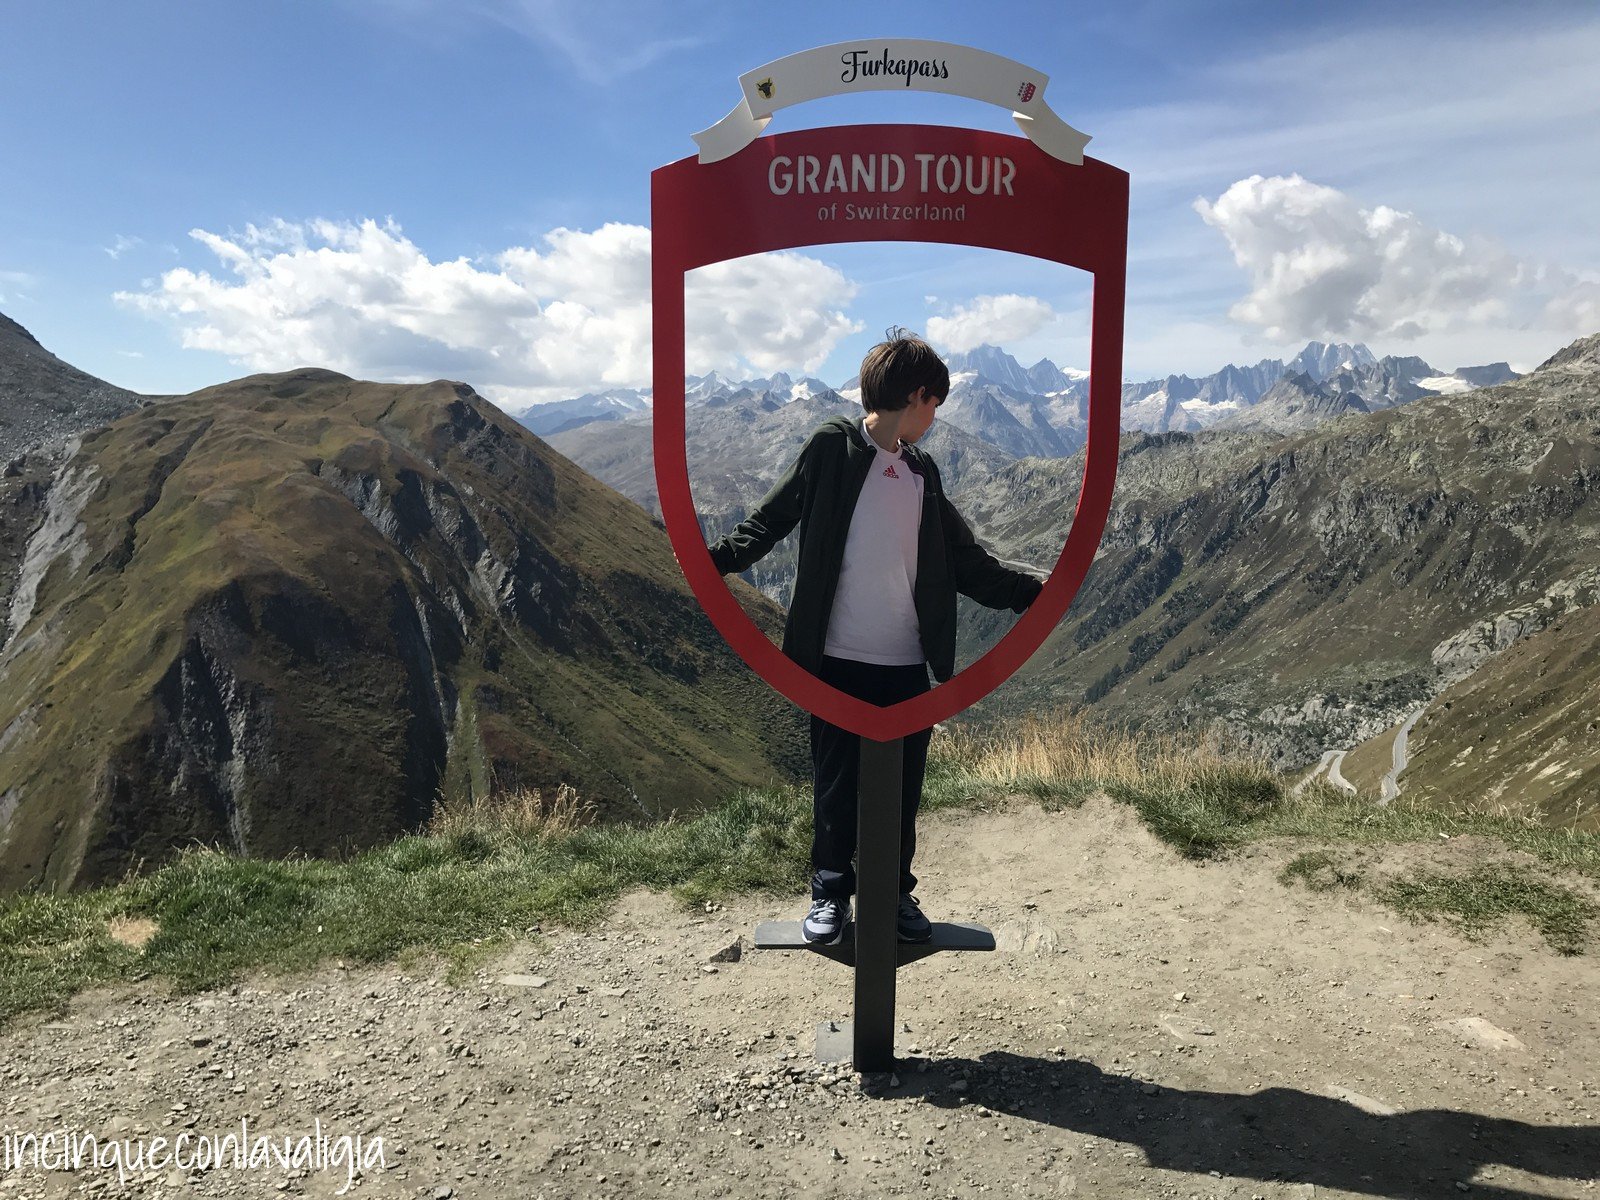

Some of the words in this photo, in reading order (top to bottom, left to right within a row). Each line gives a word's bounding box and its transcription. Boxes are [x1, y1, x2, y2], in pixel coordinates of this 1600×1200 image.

[840, 48, 949, 87] Furkapass
[768, 153, 906, 196] GRAND
[914, 153, 1017, 197] TOUR
[817, 203, 838, 221] of
[845, 202, 966, 222] Switzerland
